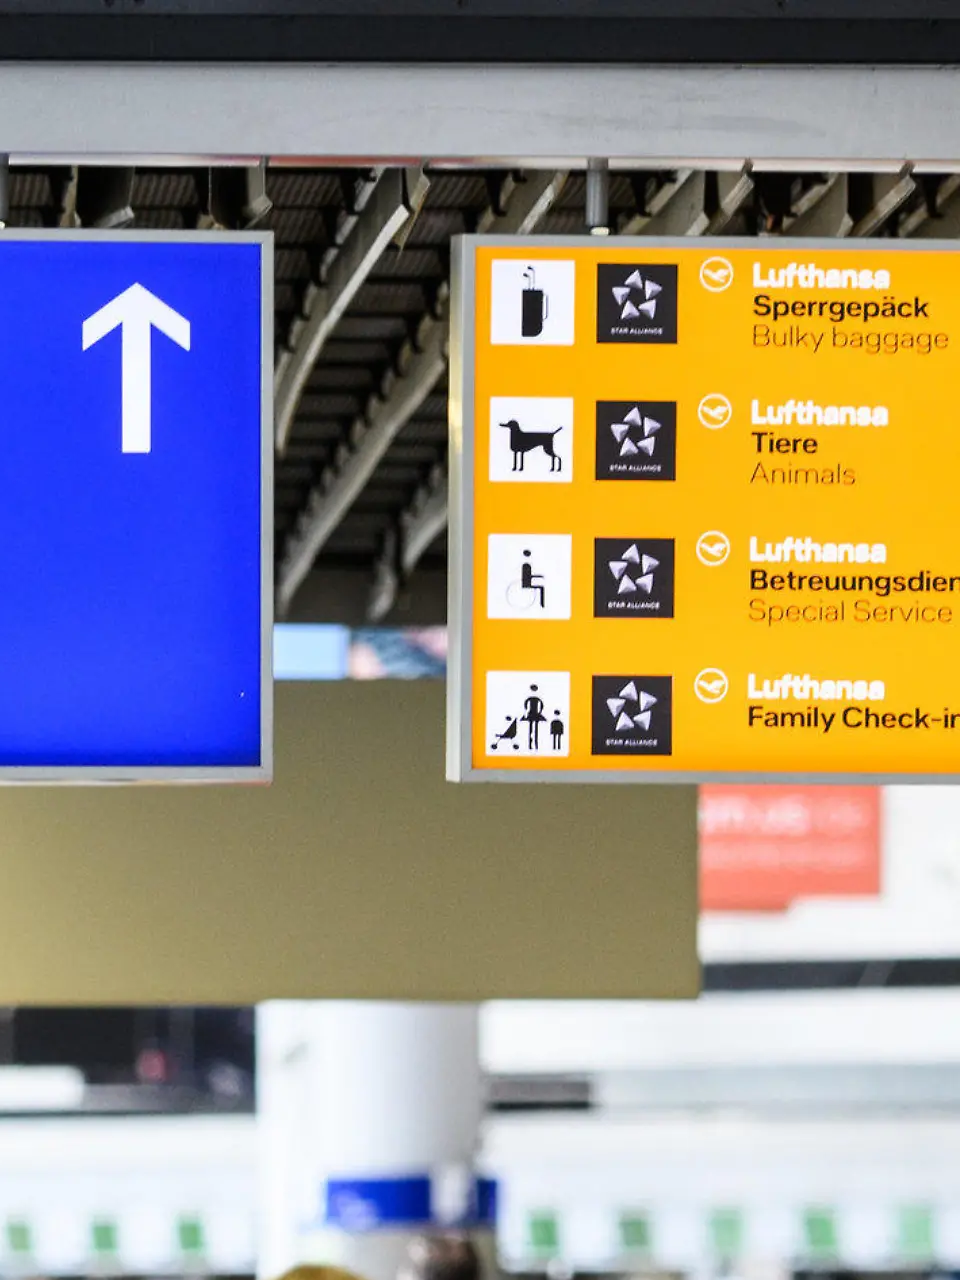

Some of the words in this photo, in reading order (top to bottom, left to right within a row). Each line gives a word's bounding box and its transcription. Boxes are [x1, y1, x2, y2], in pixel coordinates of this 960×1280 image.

[752, 261, 891, 290] Lufthansa
[752, 294, 929, 322] Sperrgepäck
[610, 327, 628, 336] STAR
[629, 327, 662, 336] ALLIANCE
[752, 324, 825, 353] Bulky
[831, 324, 949, 355] baggage
[751, 399, 889, 427] Lufthansa
[751, 430, 819, 455] Tiere
[609, 464, 627, 473] STAR
[628, 464, 661, 473] ALLIANCE
[749, 461, 856, 486] Animals
[749, 535, 887, 564] Lufthansa
[607, 601, 625, 610] STAR
[626, 601, 659, 610] ALLIANCE
[748, 598, 845, 627] Special
[853, 599, 953, 624] Service
[747, 672, 886, 701] Lufthansa
[747, 705, 837, 734] Family
[605, 738, 623, 747] STAR
[624, 738, 657, 747] ALLIANCE
